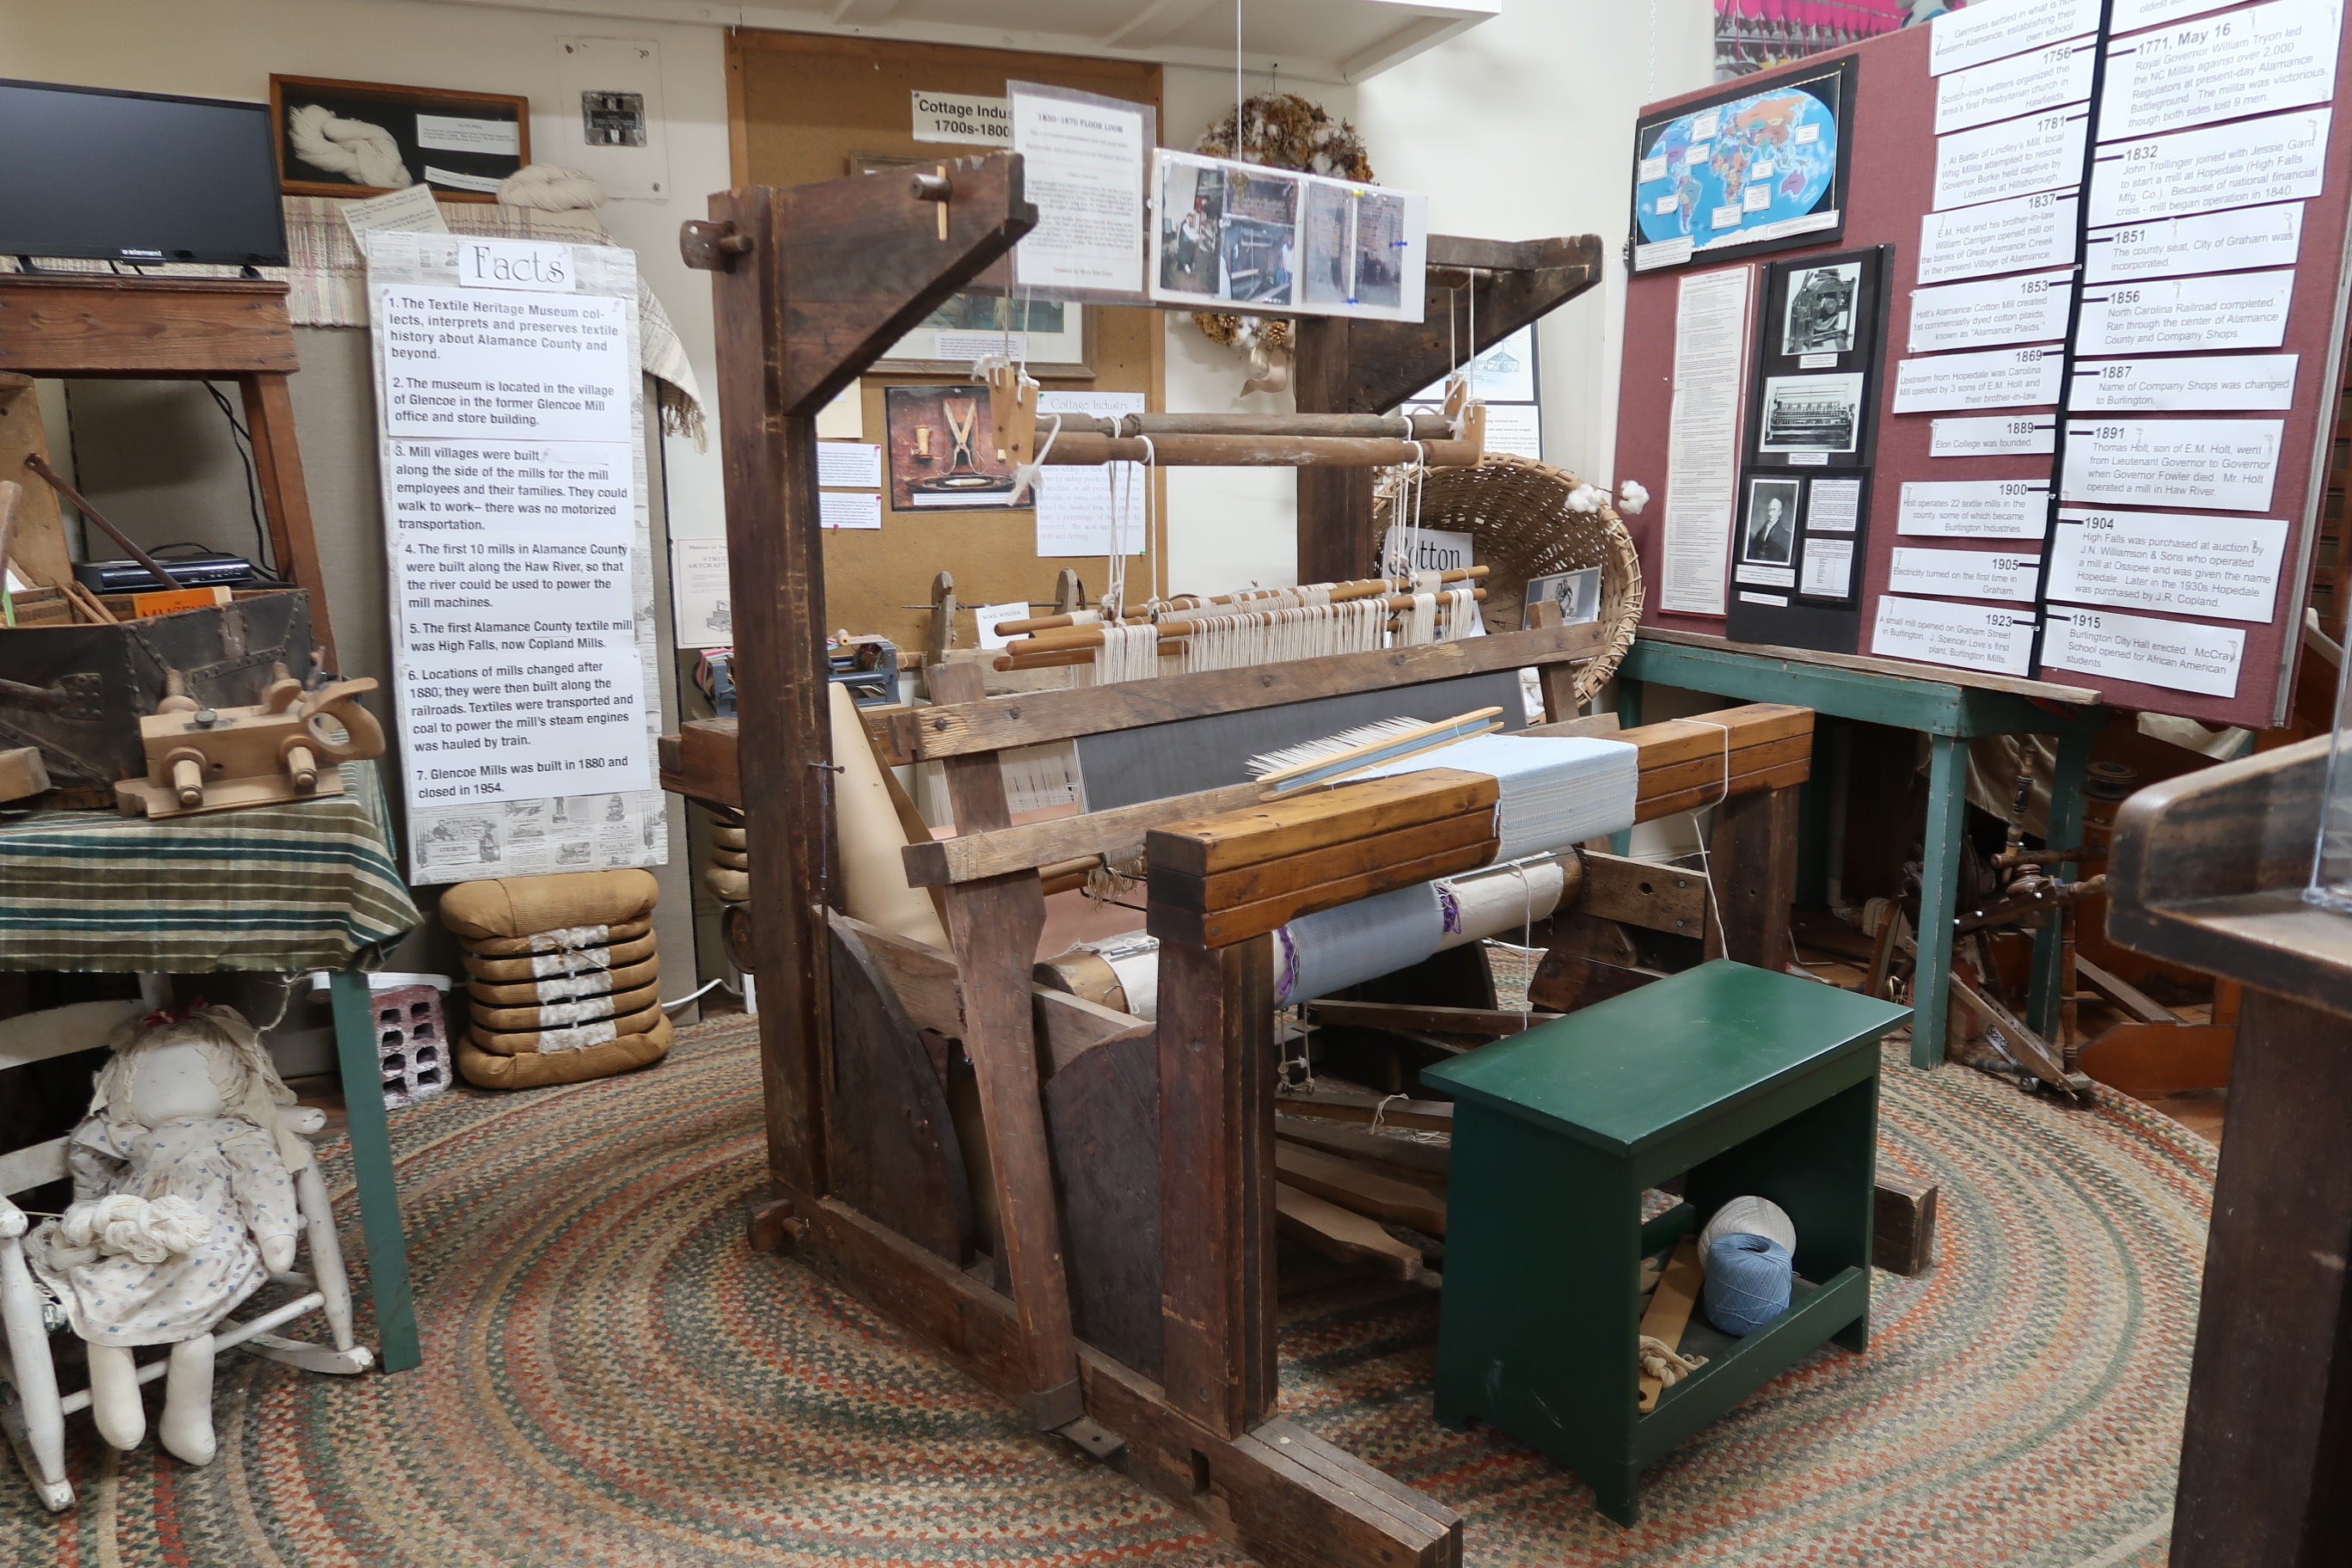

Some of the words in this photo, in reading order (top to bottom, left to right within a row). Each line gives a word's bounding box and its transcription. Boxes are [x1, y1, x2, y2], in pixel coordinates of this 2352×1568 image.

[2139, 37, 2171, 55] 1771,
[2178, 31, 2208, 46] May
[2214, 22, 2231, 38] 16
[2044, 47, 2071, 64] 1756
[919, 99, 973, 119] Cottage
[1105, 123, 1123, 133] LOOM
[2037, 115, 2064, 132] 1781
[2127, 145, 2158, 161] 1832
[2029, 193, 2055, 208] 1837
[2113, 248, 2130, 257] The
[2133, 245, 2165, 255] county
[2194, 240, 2213, 251] City
[2214, 237, 2225, 248] of
[2226, 235, 2268, 246] Graham
[2272, 232, 2294, 241] was
[2116, 230, 2145, 244] 1851
[473, 246, 564, 283] Facts
[2021, 281, 2049, 295] 1853
[2110, 291, 2140, 304] 1856
[389, 297, 399, 308] 1.
[401, 297, 425, 309] The
[428, 299, 469, 311] Textile
[473, 301, 524, 316] Heritage
[529, 304, 578, 317] Museum
[583, 309, 604, 318] col-
[2108, 308, 2132, 317] North
[2135, 305, 2172, 315] Carolina
[2176, 302, 2217, 313] Railroad
[389, 314, 424, 327] lects,
[428, 315, 488, 329] interprets
[493, 320, 515, 330] and
[519, 322, 578, 334] preserves
[581, 325, 618, 335] textile
[2107, 322, 2124, 331] Ran
[2127, 319, 2160, 330] through
[2163, 318, 2178, 327] the
[2181, 316, 2213, 326] center
[2214, 315, 2226, 324] of
[2226, 314, 2279, 323] Alamance
[390, 330, 434, 344] history
[439, 333, 475, 344] about
[478, 334, 536, 347] Alamance
[542, 337, 581, 352] County
[586, 341, 607, 351] and
[2104, 335, 2136, 346] County
[2137, 334, 2154, 342] and
[2157, 332, 2203, 342] Company
[391, 347, 440, 360] beyond.
[2016, 350, 2043, 362] 1869
[2103, 366, 2132, 378] 1887
[393, 377, 404, 388] 2.
[406, 377, 428, 389] The
[432, 381, 481, 390] museum
[486, 381, 495, 391] is
[499, 382, 540, 393] located
[544, 383, 554, 393] in
[557, 383, 574, 394] the
[579, 385, 614, 397] village
[2099, 383, 2125, 391] Name
[2128, 382, 2137, 390] of
[2139, 382, 2185, 392] Company
[2187, 381, 2218, 392] Shops
[2245, 379, 2290, 391] changed
[395, 394, 406, 404] of
[409, 394, 456, 406] Glencoe
[460, 395, 470, 406] in
[474, 397, 492, 407] the
[495, 397, 534, 408] former
[537, 399, 581, 410] Glencoe
[585, 401, 604, 411] Mill
[1051, 399, 1089, 413] Cottage
[1093, 400, 1129, 413] Industry
[395, 411, 428, 421] office
[432, 413, 454, 422] and
[457, 413, 487, 423] store
[490, 413, 539, 426] building.
[2007, 422, 2033, 433] 1889
[2096, 427, 2124, 438] 1891
[1953, 440, 1981, 450] College
[2000, 484, 2027, 495] 1900
[2086, 518, 2114, 530] 1904
[1993, 559, 2018, 571] 1905
[409, 624, 420, 634] 5.
[423, 623, 444, 633] The
[447, 622, 471, 633] first
[475, 622, 530, 632] Alamance
[535, 622, 572, 633] County
[575, 621, 609, 631] textile
[613, 621, 632, 629] mill
[1986, 614, 2012, 627] 1923
[2073, 615, 2100, 628] 1915
[411, 643, 435, 652] was
[438, 640, 464, 652] High
[469, 640, 498, 650] Falls,
[529, 639, 574, 651] Copland
[578, 638, 606, 648] Mills.
[2070, 629, 2112, 643] Burlington
[2115, 636, 2131, 647] City
[2134, 639, 2149, 648] Hall
[2195, 647, 2236, 663] McCray
[2068, 641, 2097, 653] School
[2099, 648, 2131, 658] opened
[2134, 652, 2146, 661] for
[2147, 654, 2177, 667] African
[2178, 659, 2226, 674] American
[414, 743, 438, 751] was
[442, 738, 481, 750] hauled
[484, 738, 497, 749] by
[500, 735, 530, 746] train.
[416, 770, 427, 781] 7.
[431, 769, 476, 779] Glencoe
[480, 765, 507, 775] Mills
[511, 765, 534, 774] was
[537, 762, 562, 772] built
[566, 760, 575, 769] in
[579, 758, 604, 769] 1880
[609, 756, 628, 767] and
[419, 786, 456, 798] closed
[460, 786, 470, 794] in
[474, 782, 504, 793] 1954.
